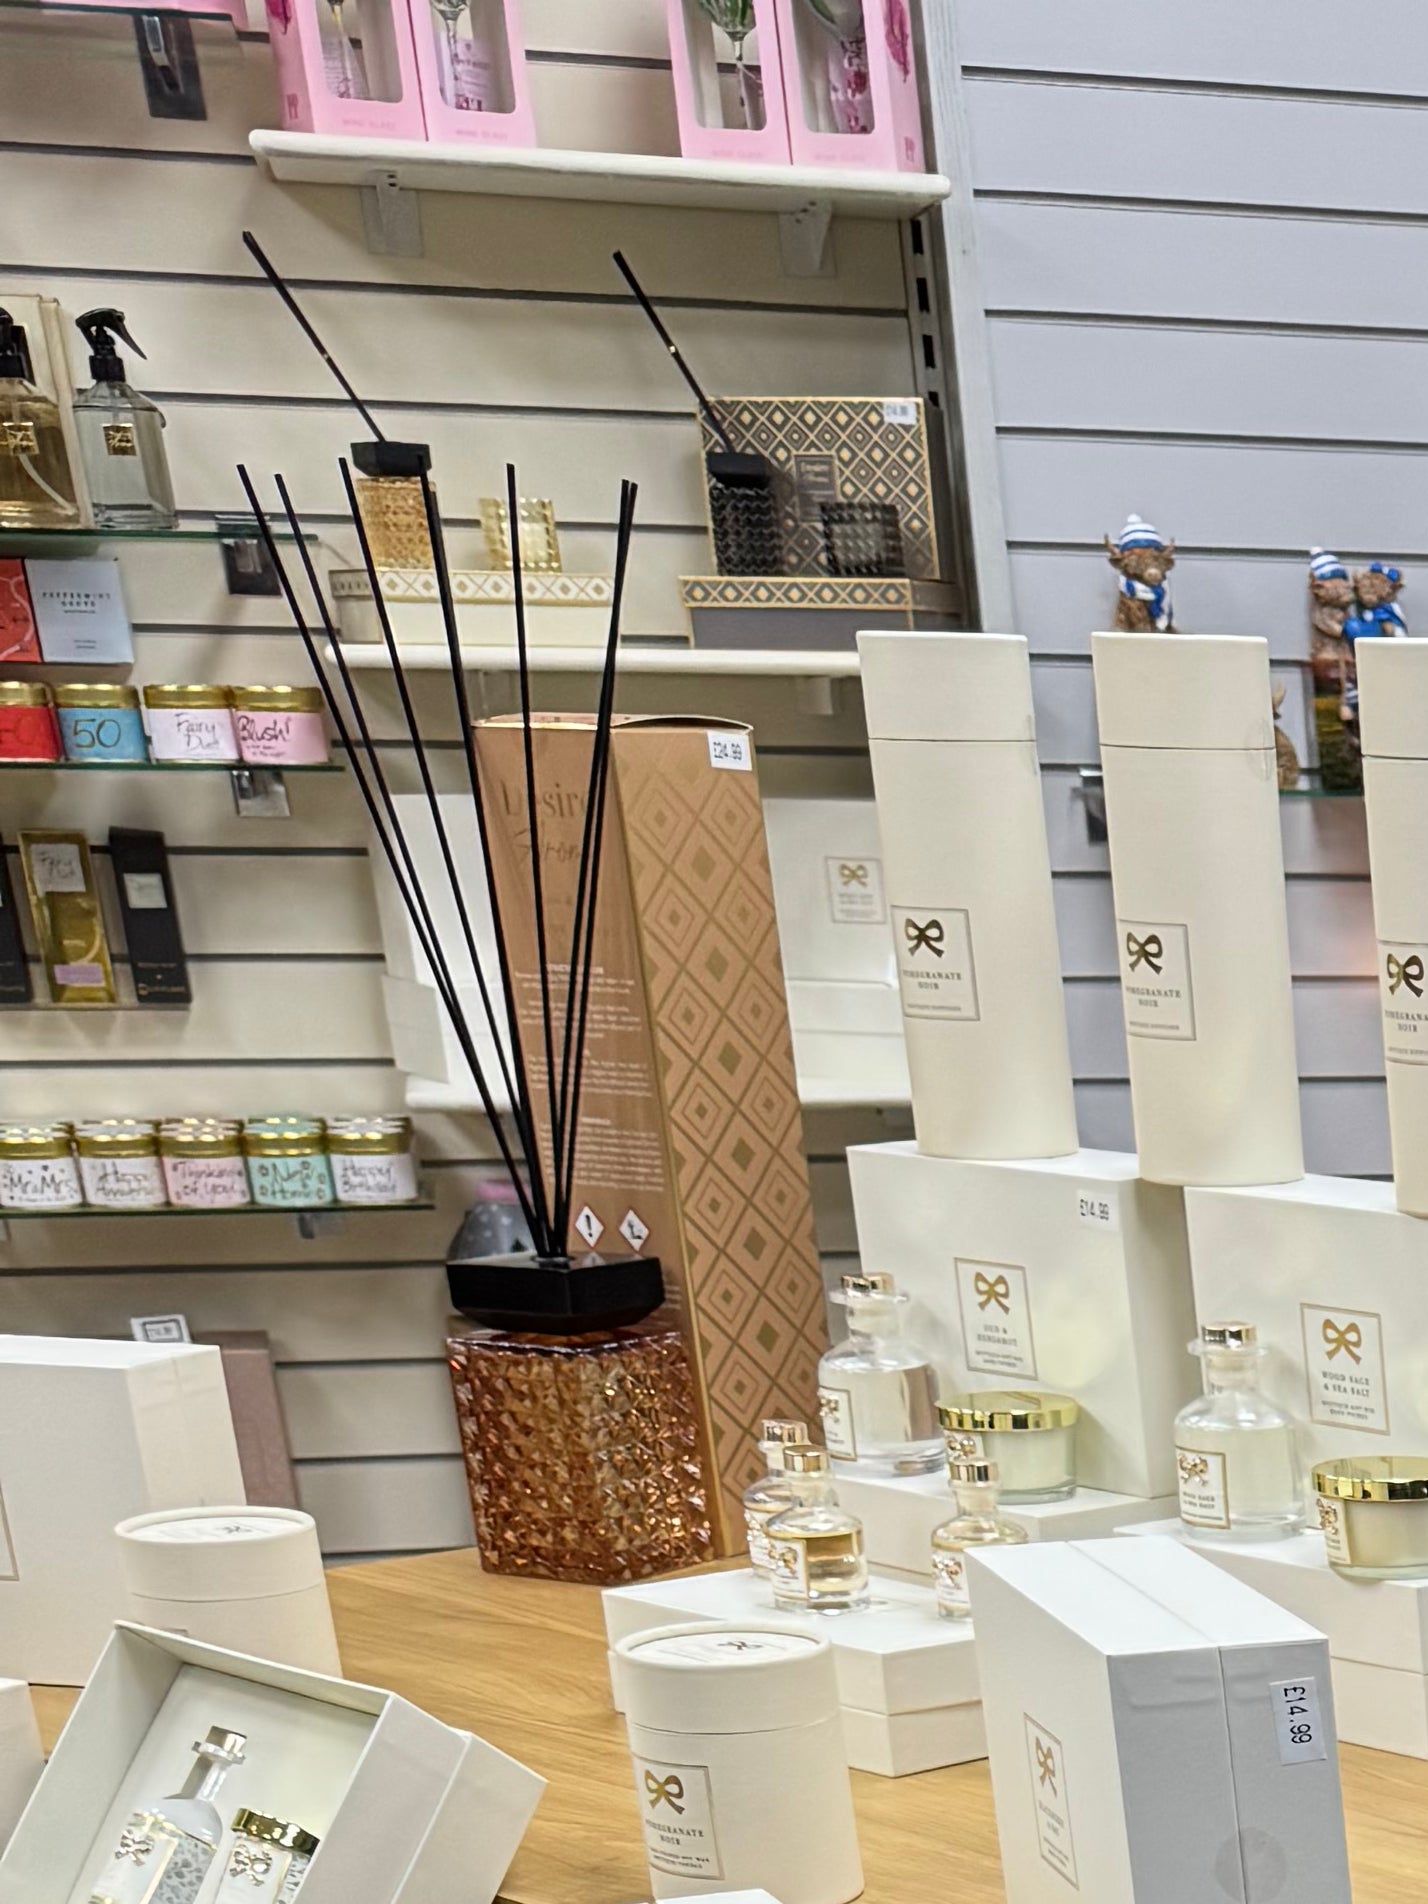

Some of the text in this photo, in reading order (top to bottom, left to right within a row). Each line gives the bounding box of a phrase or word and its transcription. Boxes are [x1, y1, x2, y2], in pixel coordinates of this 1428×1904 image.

[71, 718, 122, 750] 50
[1321, 1370, 1346, 1382] WOOD
[1283, 1686, 1313, 1744] £14.99
